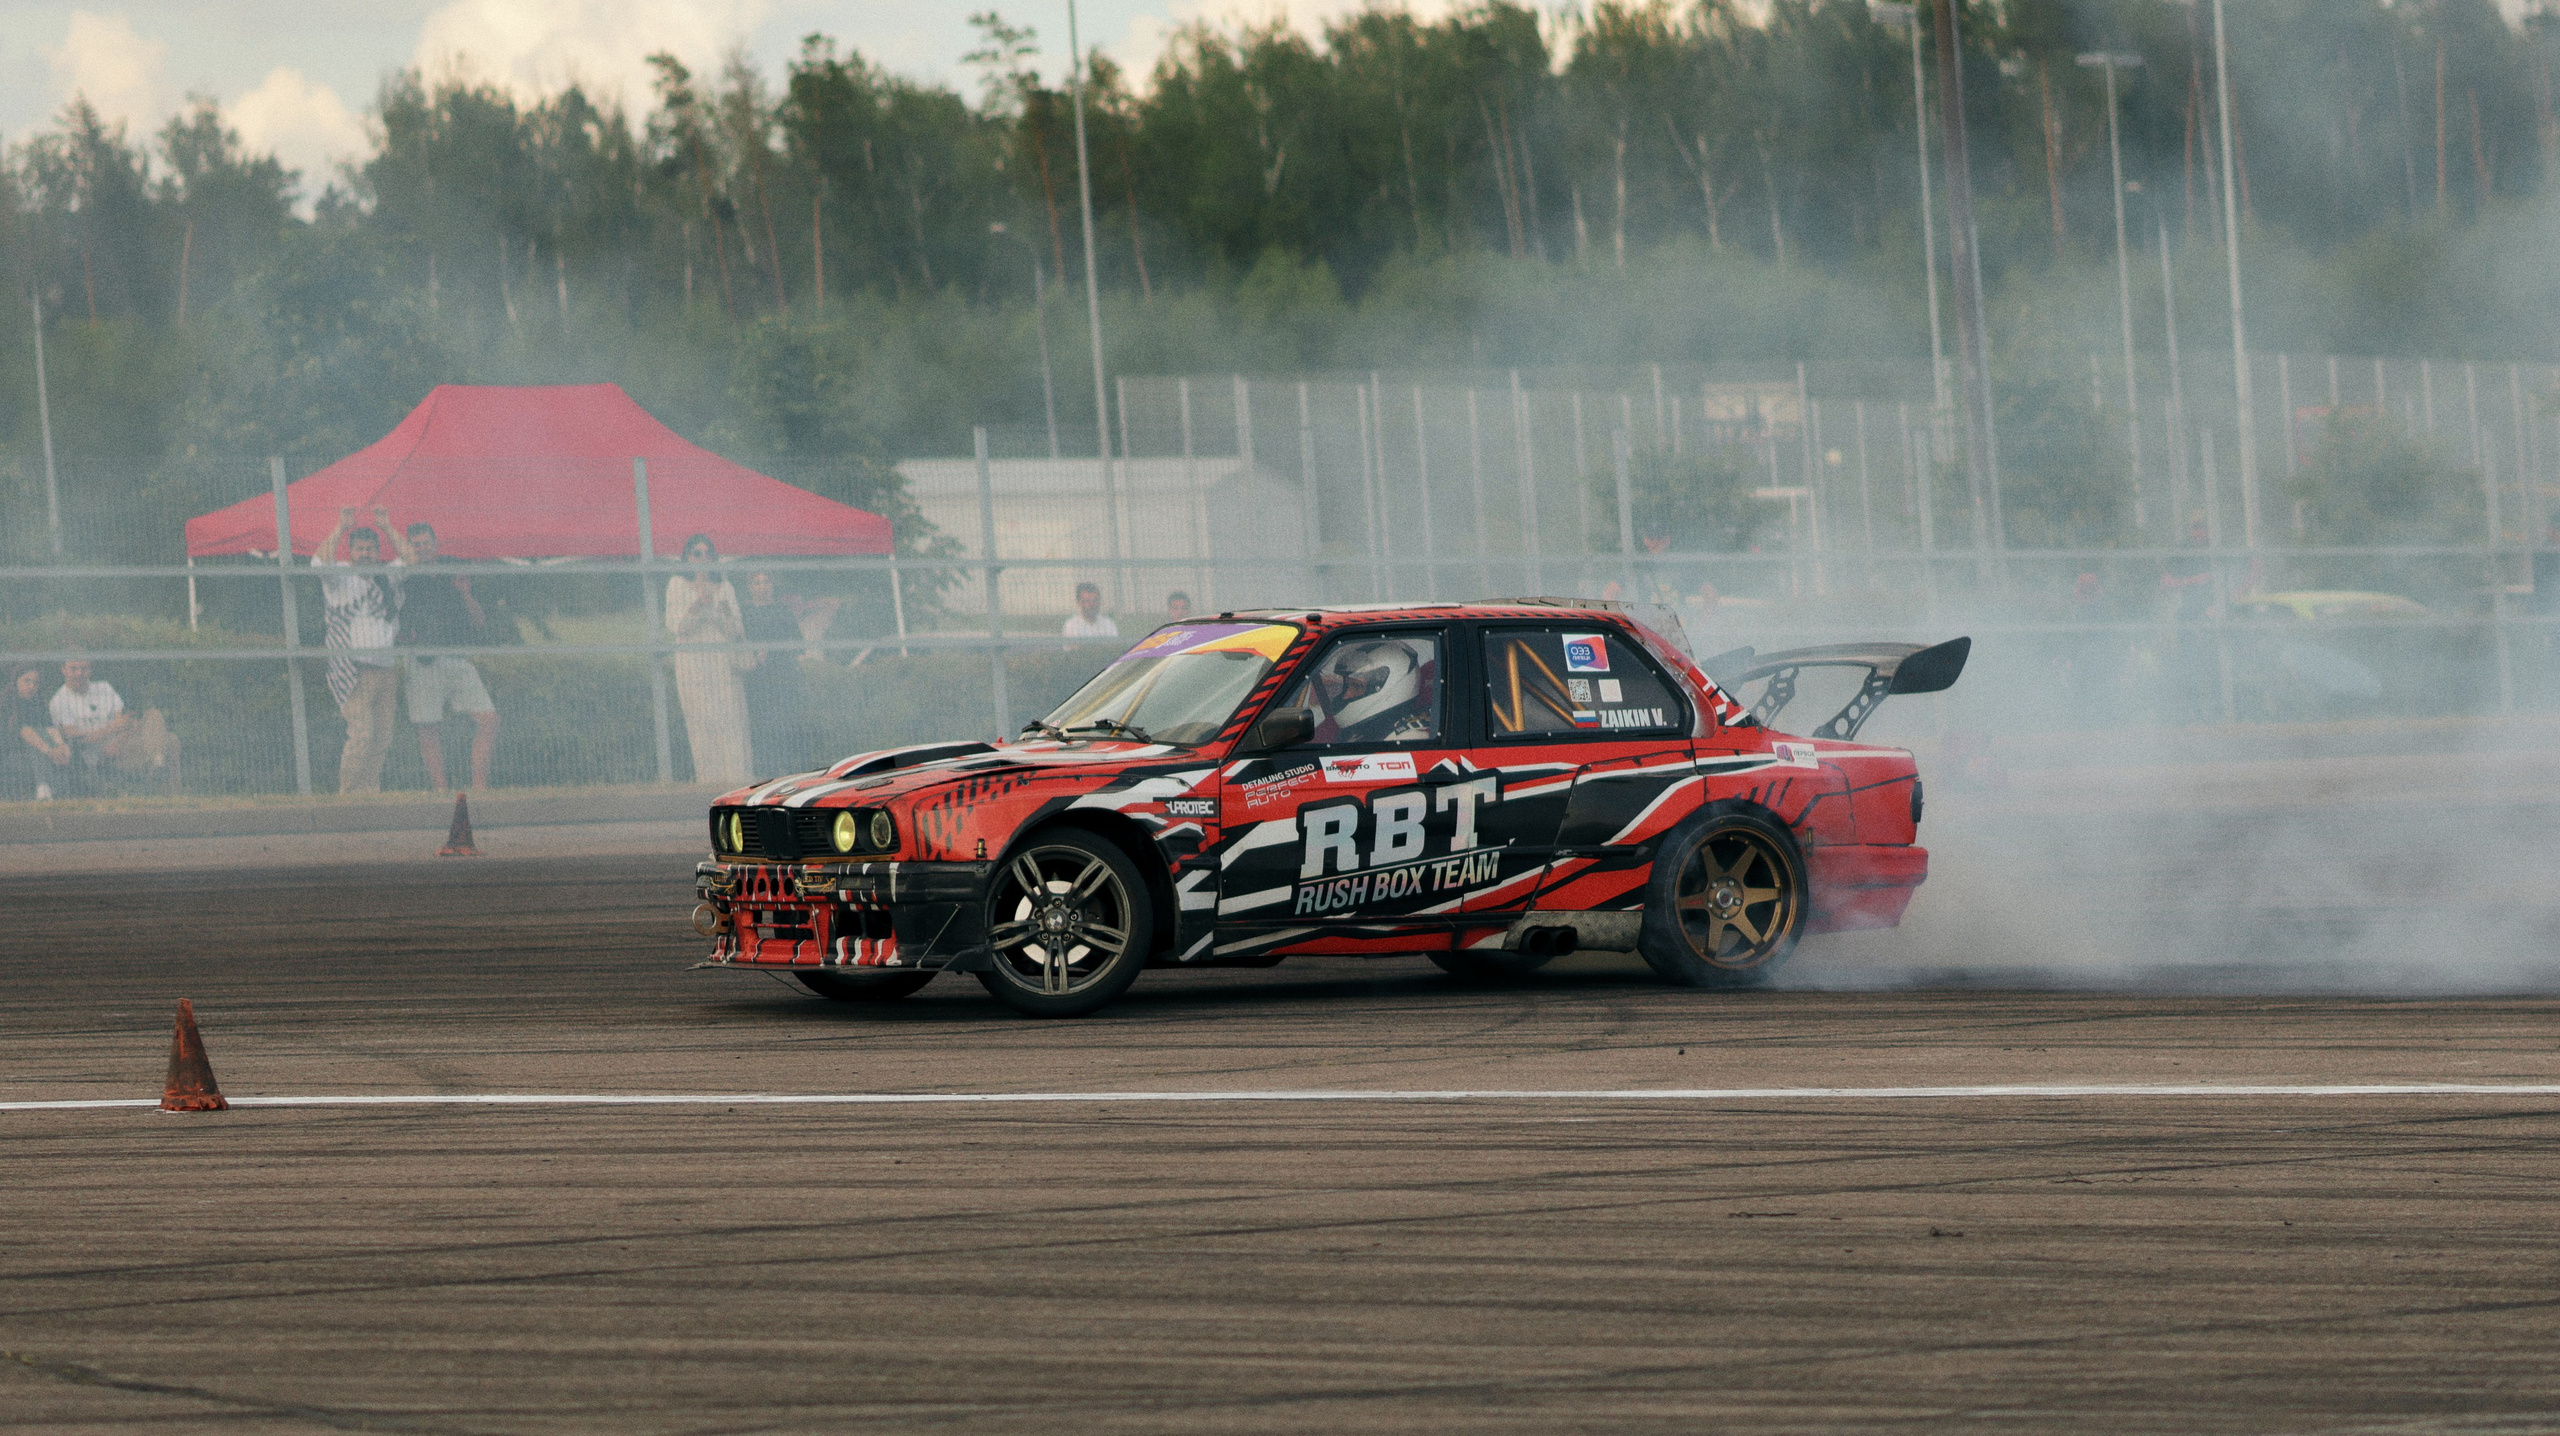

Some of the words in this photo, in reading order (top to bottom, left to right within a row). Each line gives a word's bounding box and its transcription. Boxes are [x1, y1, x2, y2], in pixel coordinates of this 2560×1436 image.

[1599, 708, 1651, 728] ZAIKIN
[1651, 708, 1667, 726] V.
[1242, 772, 1285, 791] DETAILING
[1284, 763, 1315, 778] STUDIO
[1245, 771, 1318, 800] PERFECT
[1247, 789, 1291, 809] AUTO
[1300, 776, 1497, 879] RBT
[1295, 877, 1371, 915] RUSH
[1371, 863, 1423, 903] BOX
[1432, 850, 1499, 891] TEAM
